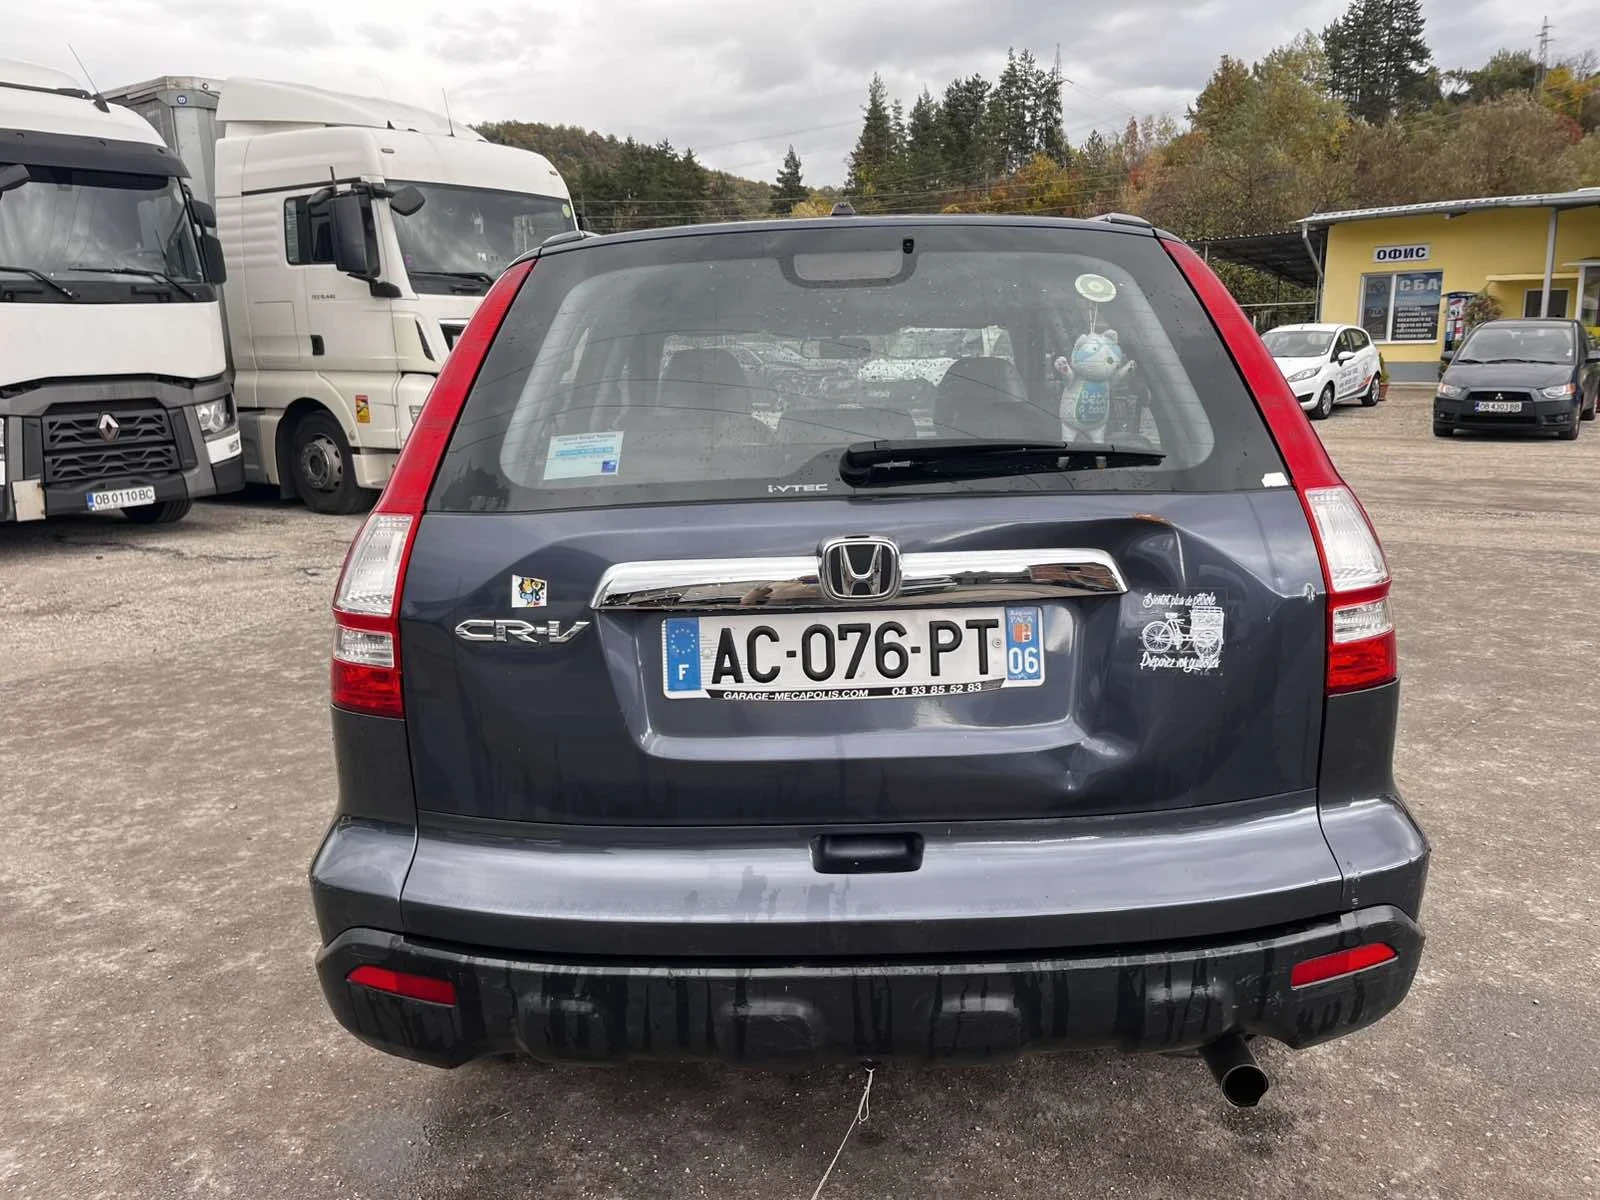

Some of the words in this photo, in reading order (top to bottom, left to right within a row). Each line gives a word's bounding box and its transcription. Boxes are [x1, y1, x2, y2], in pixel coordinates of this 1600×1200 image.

[1376, 247, 1426, 260] ОФИС
[1400, 278, 1439, 291] СБА
[455, 619, 590, 643] CR-V
[711, 618, 1000, 685] AC-076-PT
[1008, 647, 1039, 674] 06
[678, 664, 690, 681] F
[723, 690, 869, 701] GARAGE-MECAPOLIS.COM
[892, 687, 907, 696] 04
[911, 686, 926, 695] 93
[930, 685, 945, 694] 85
[950, 684, 964, 693] 52
[967, 682, 982, 692] 83
